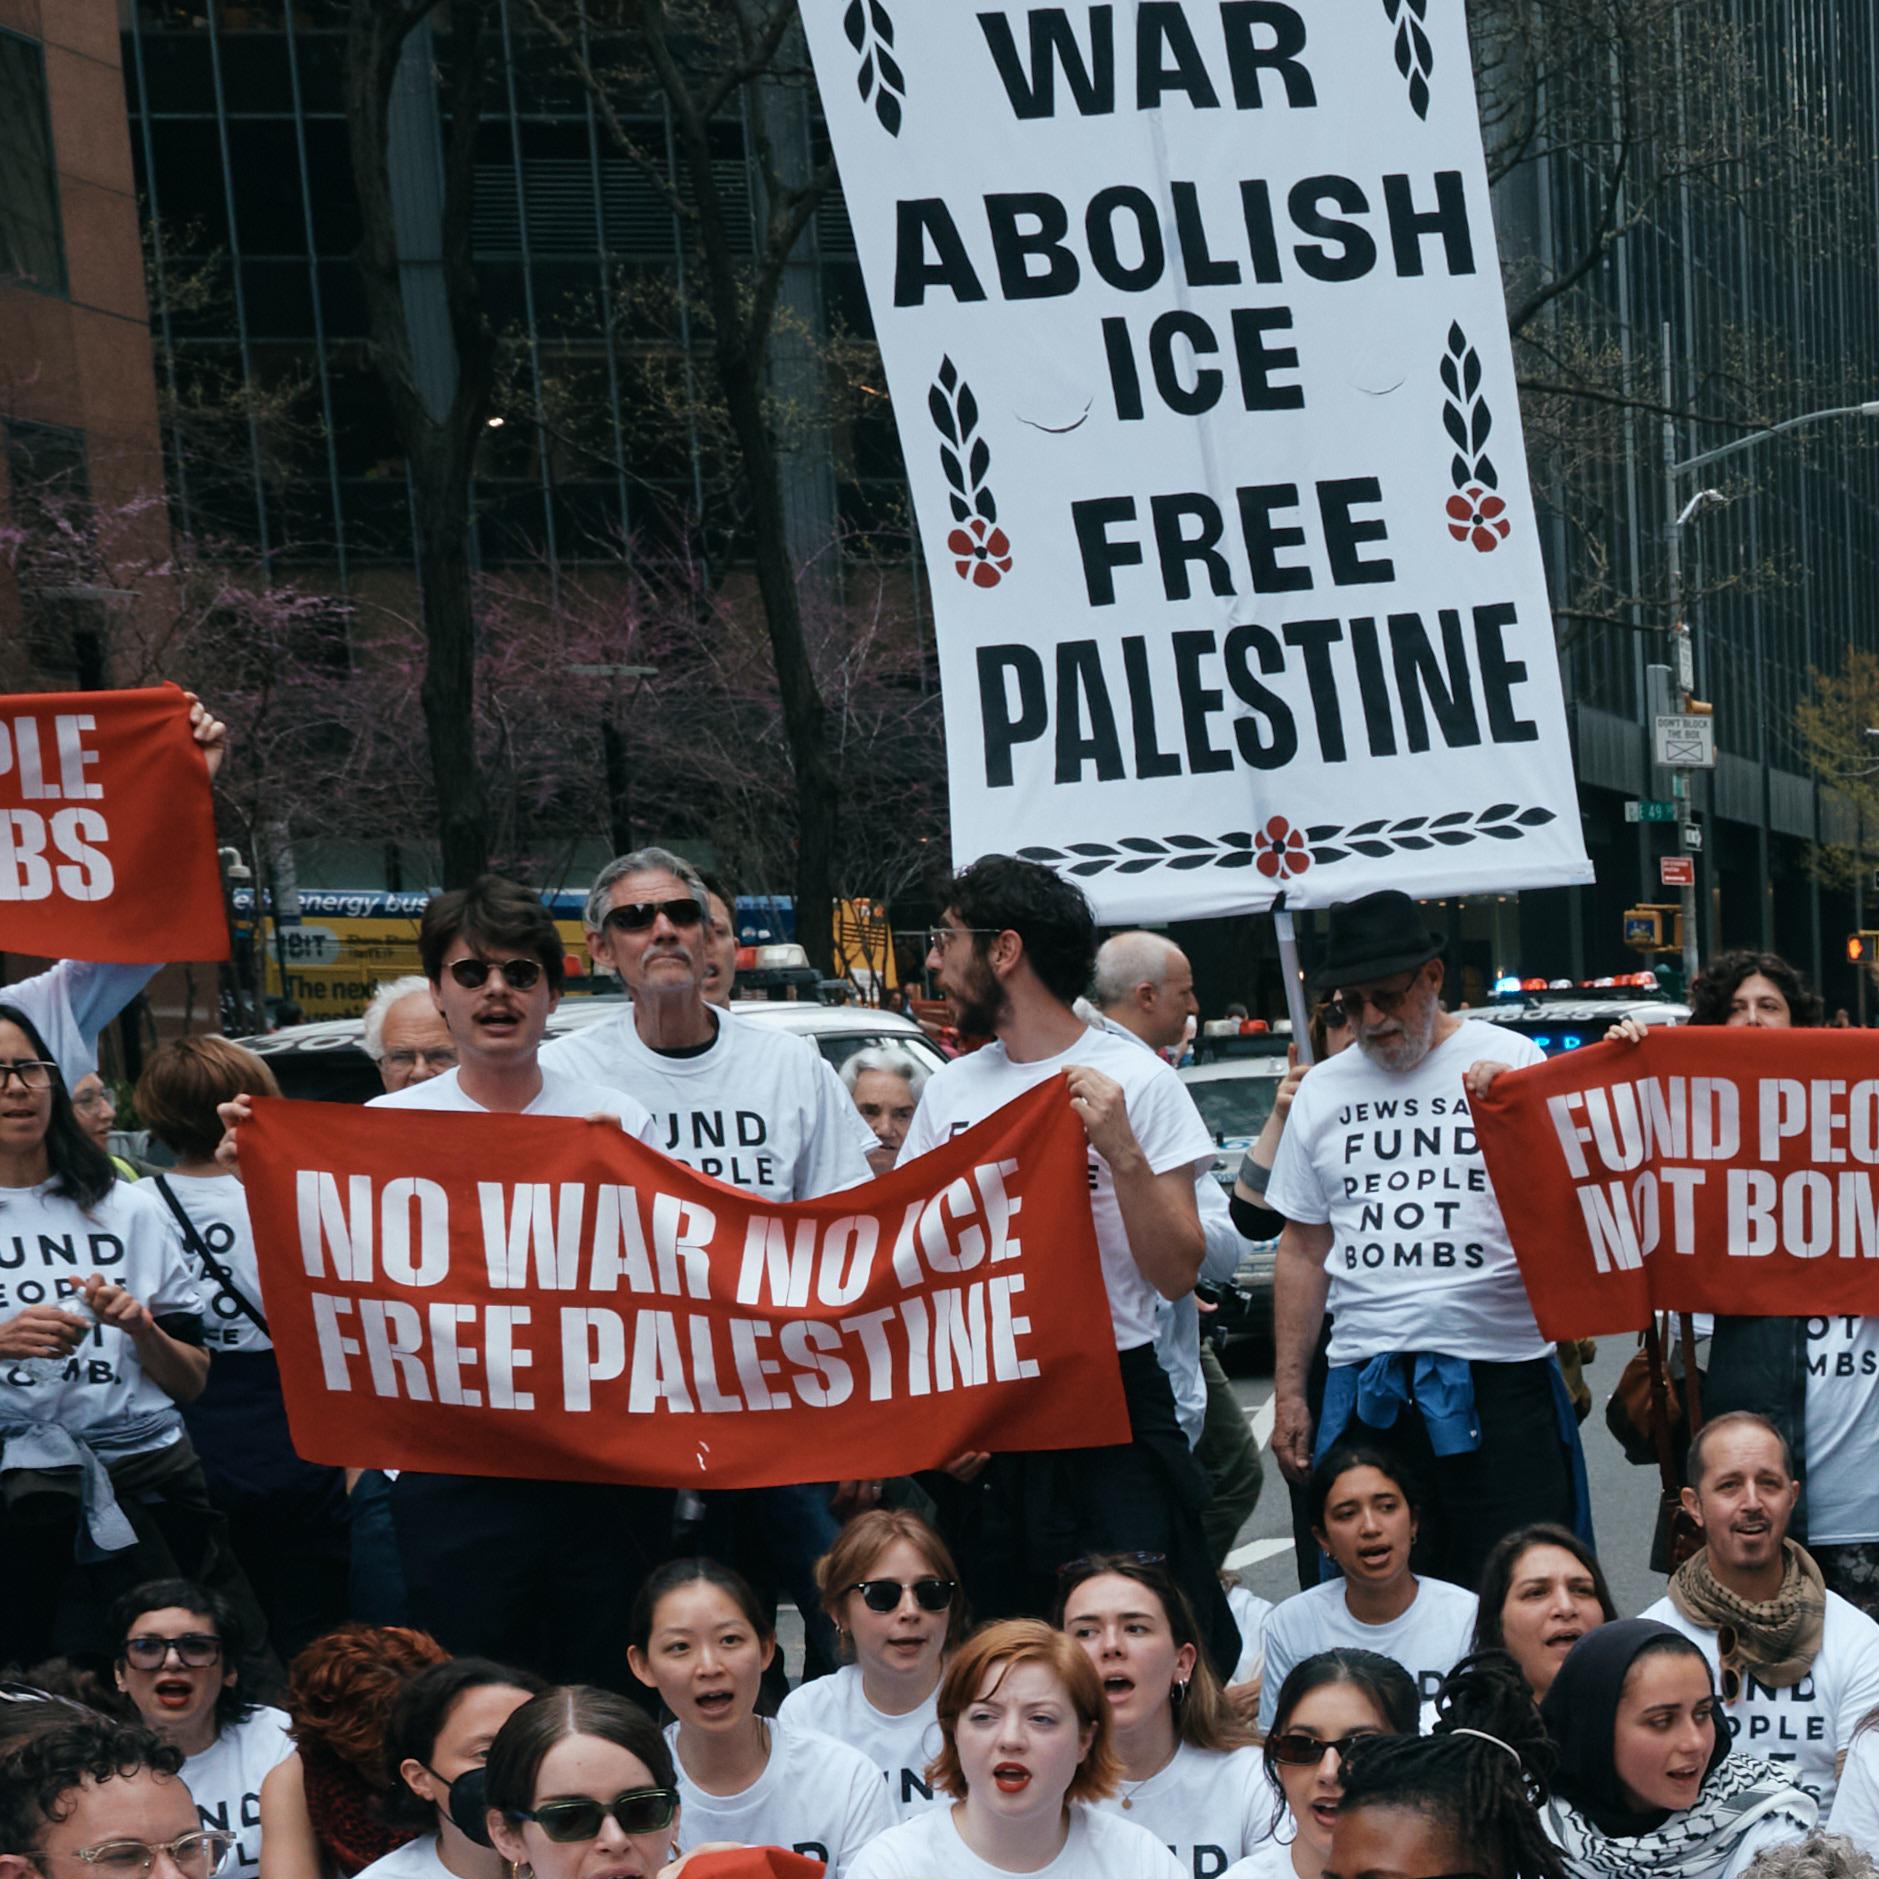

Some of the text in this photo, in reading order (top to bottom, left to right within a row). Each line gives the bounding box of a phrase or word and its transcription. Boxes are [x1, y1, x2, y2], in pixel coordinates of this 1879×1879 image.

[975, 0, 1318, 120] WAR
[893, 170, 1477, 313] ABOLISH
[1101, 305, 1305, 421] ICE
[1070, 476, 1396, 607] FREE
[976, 602, 1539, 788] PALESTINE
[297, 892, 380, 917] energy
[1339, 1092, 1470, 1125] JEWS SA
[1345, 1123, 1481, 1164] FUND
[1546, 1073, 1742, 1180] FUND
[296, 1170, 450, 1287] NO
[477, 1181, 716, 1300] WAR
[736, 1225, 879, 1308] NO
[892, 1157, 1023, 1290] ICE
[1343, 1167, 1486, 1200] PEOPLE
[1359, 1201, 1460, 1232] NOT
[1575, 1166, 1707, 1274] NOT
[1345, 1242, 1485, 1270] BOMBS
[311, 1273, 1042, 1413] FREE PALESTINE
